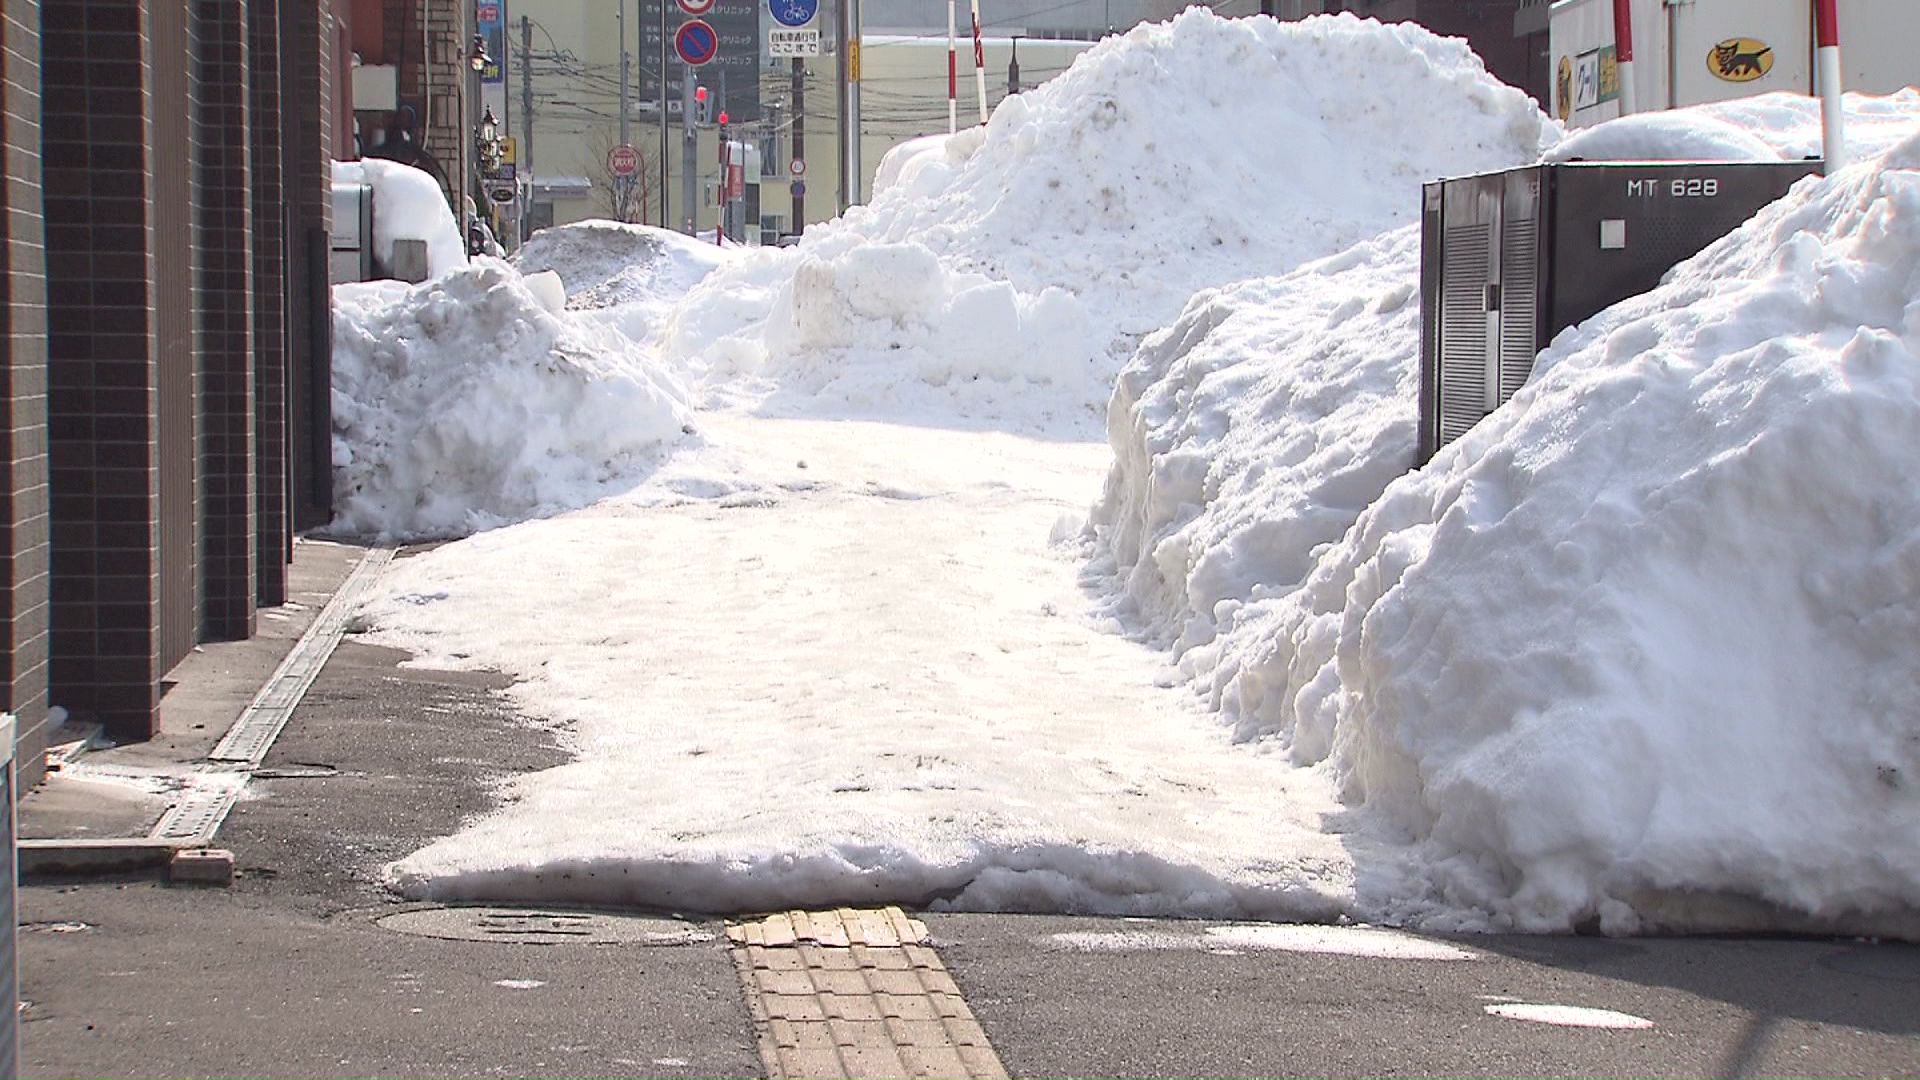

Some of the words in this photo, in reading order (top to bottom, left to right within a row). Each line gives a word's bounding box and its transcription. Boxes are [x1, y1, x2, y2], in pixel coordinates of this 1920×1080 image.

[771, 43, 817, 53] ここまで
[1627, 179, 1658, 197] MT
[1671, 179, 1717, 197] 628
